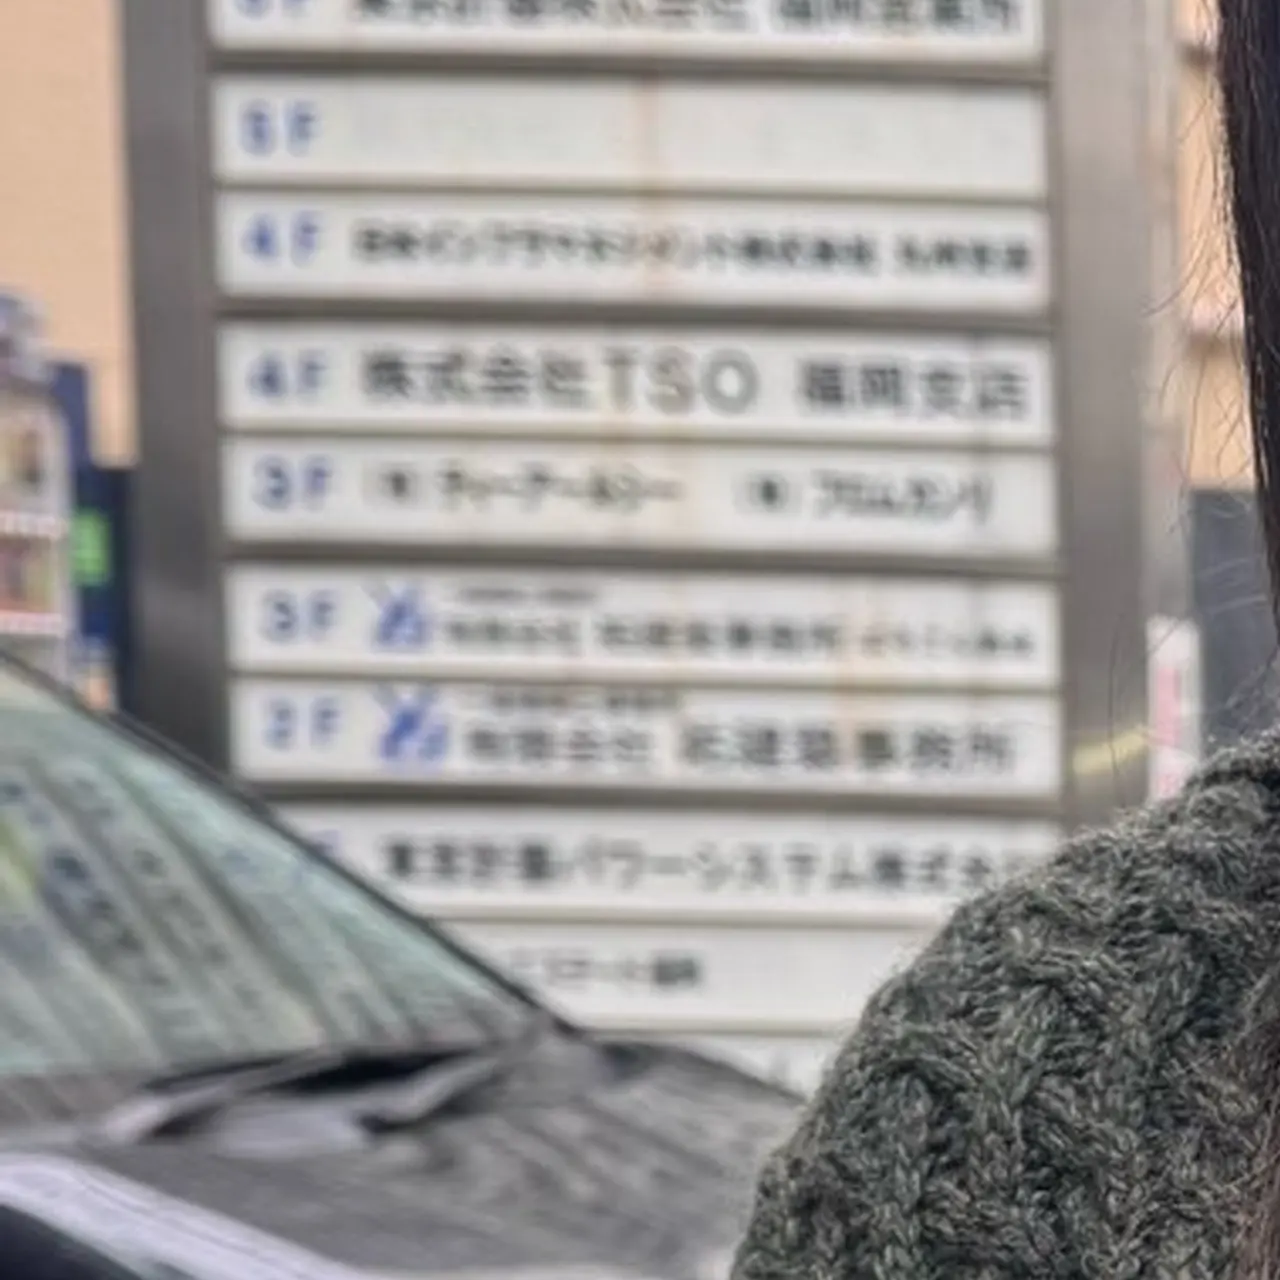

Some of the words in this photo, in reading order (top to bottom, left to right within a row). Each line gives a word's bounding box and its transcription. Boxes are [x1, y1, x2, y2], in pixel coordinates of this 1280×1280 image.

[247, 350, 328, 400] 4F
[797, 357, 1030, 419] 福岡支店
[254, 457, 333, 509] 3F
